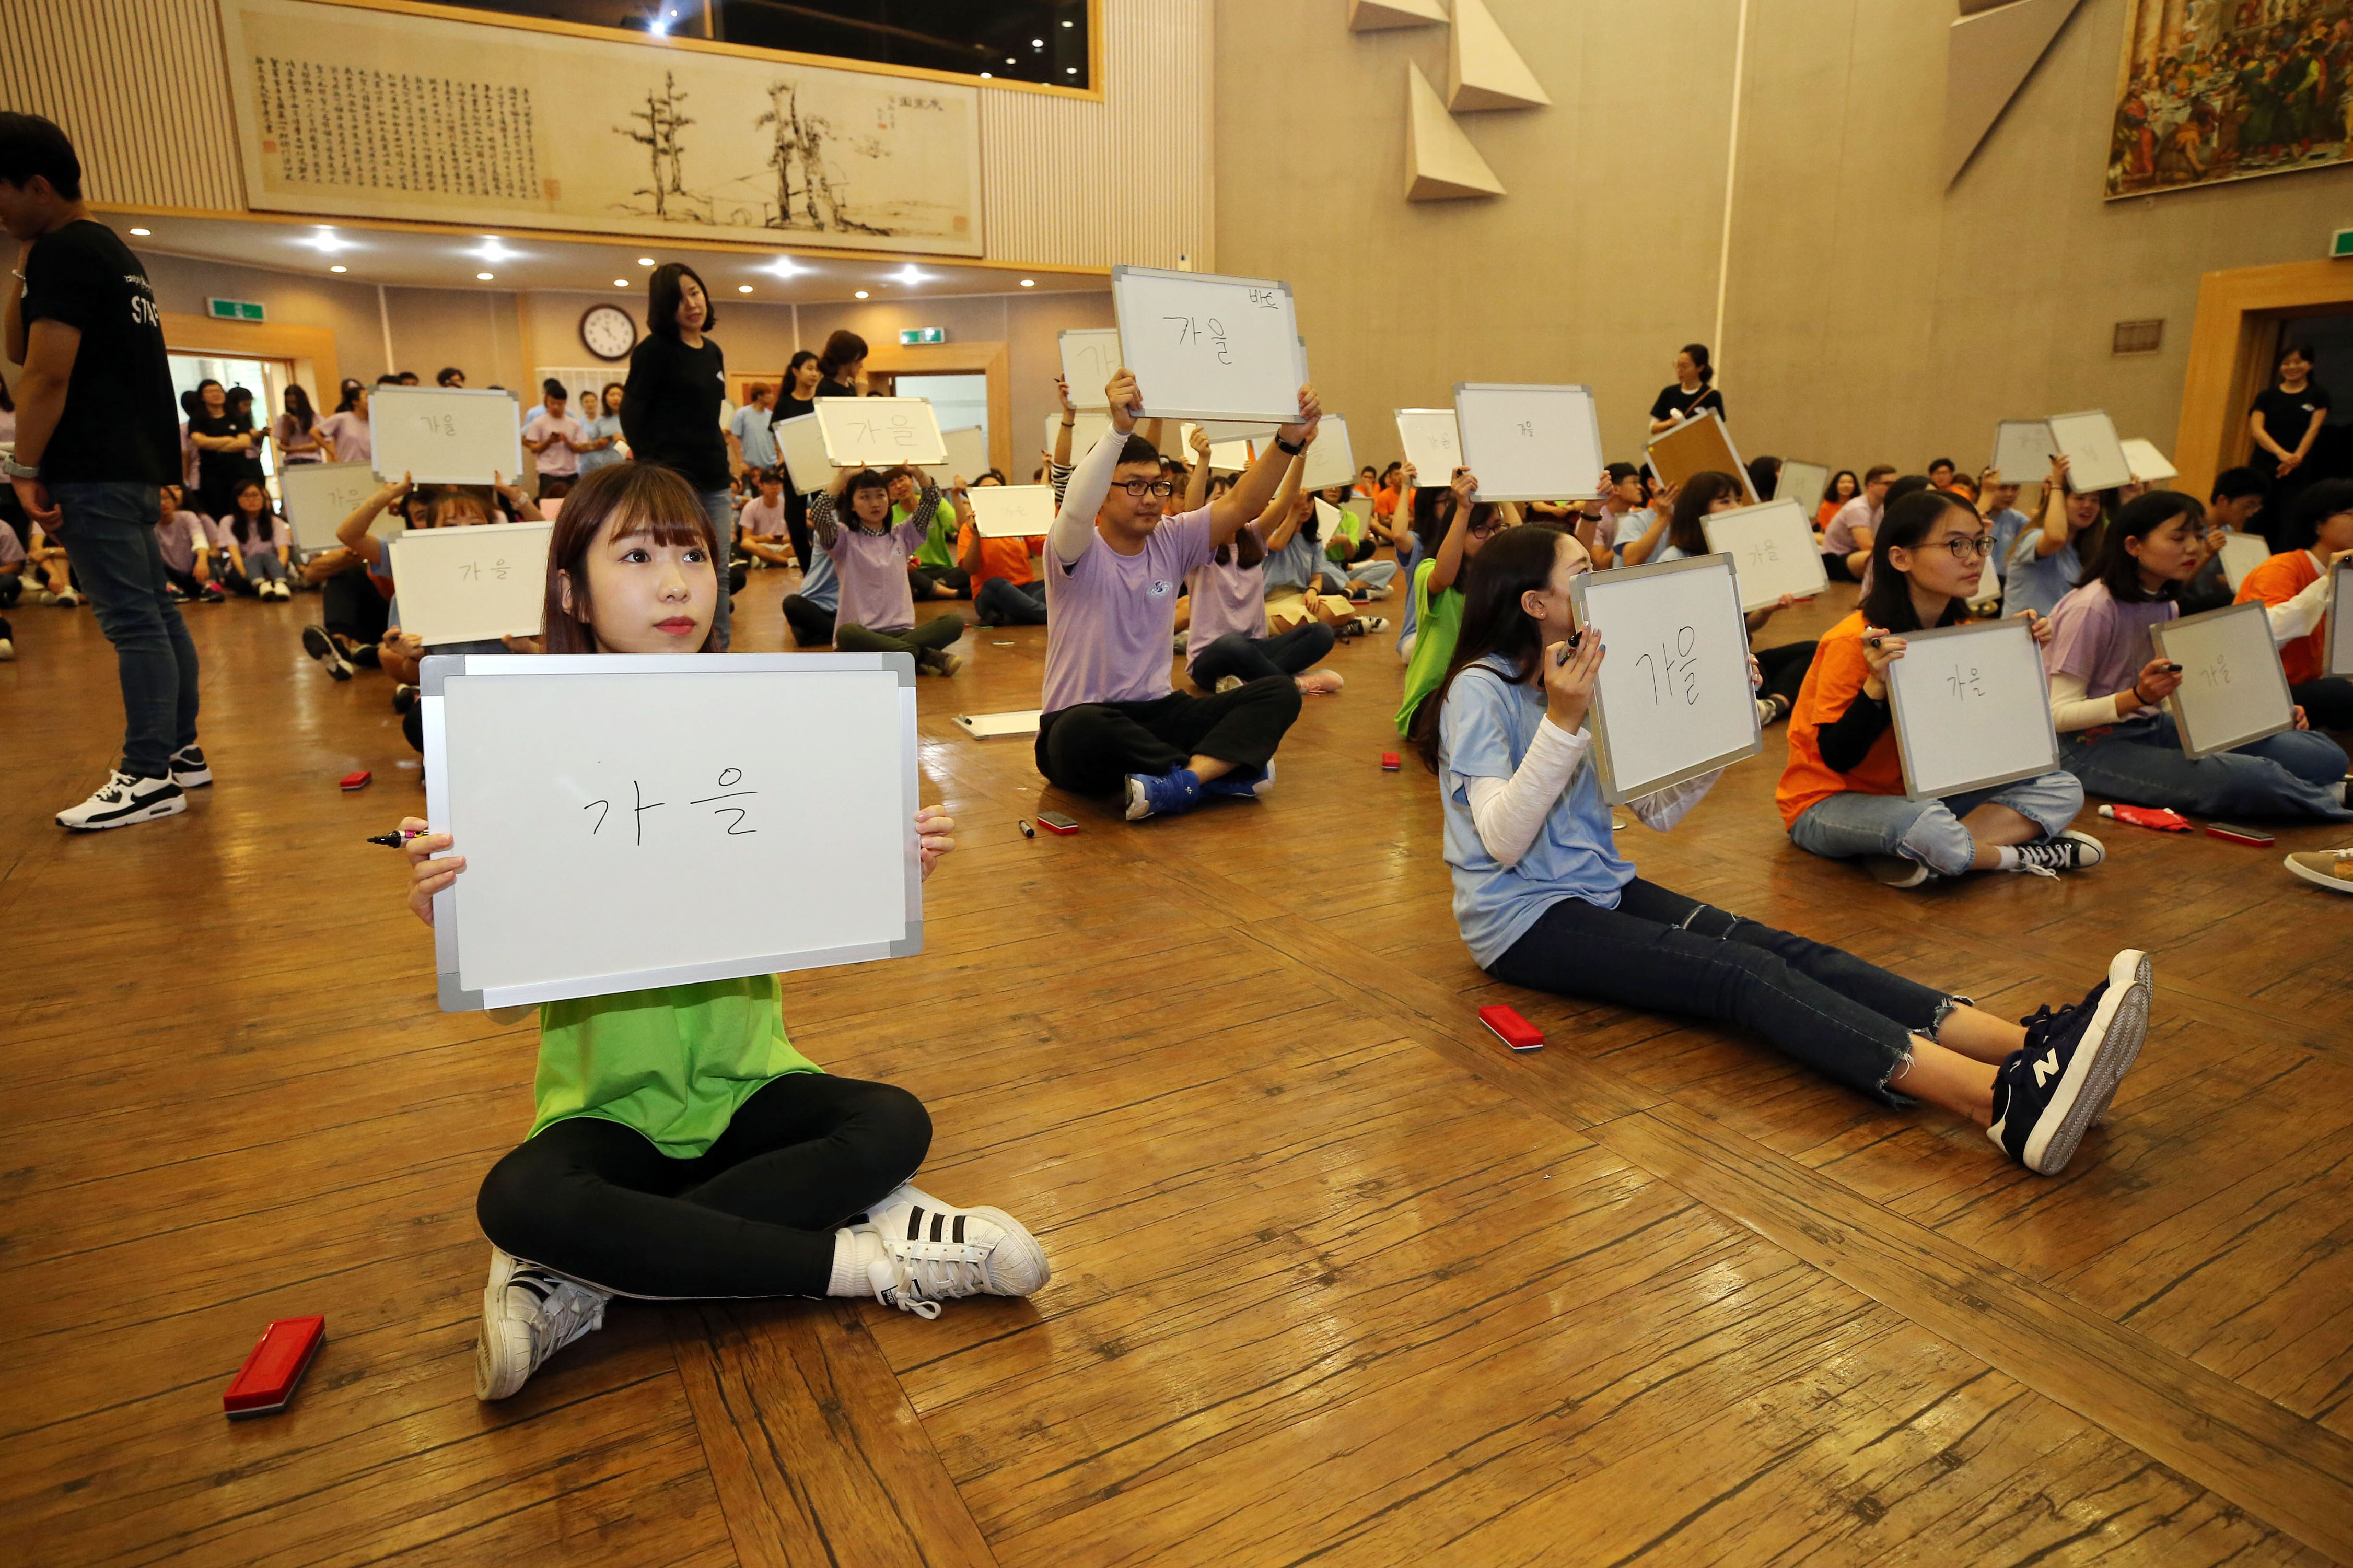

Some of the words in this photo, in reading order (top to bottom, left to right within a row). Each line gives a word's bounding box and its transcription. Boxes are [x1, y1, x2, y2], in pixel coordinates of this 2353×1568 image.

[1163, 317, 1232, 365] 가을
[1076, 343, 1121, 380] 가
[420, 414, 456, 436] 가을
[847, 414, 918, 446] 가을
[1517, 420, 1534, 437] 가을
[458, 558, 511, 581] 가을
[1748, 539, 1780, 567] 가을
[1636, 626, 1699, 706] 가을
[1947, 664, 1986, 701] 가을
[2200, 654, 2231, 687] 가을
[584, 768, 758, 846] 가을
